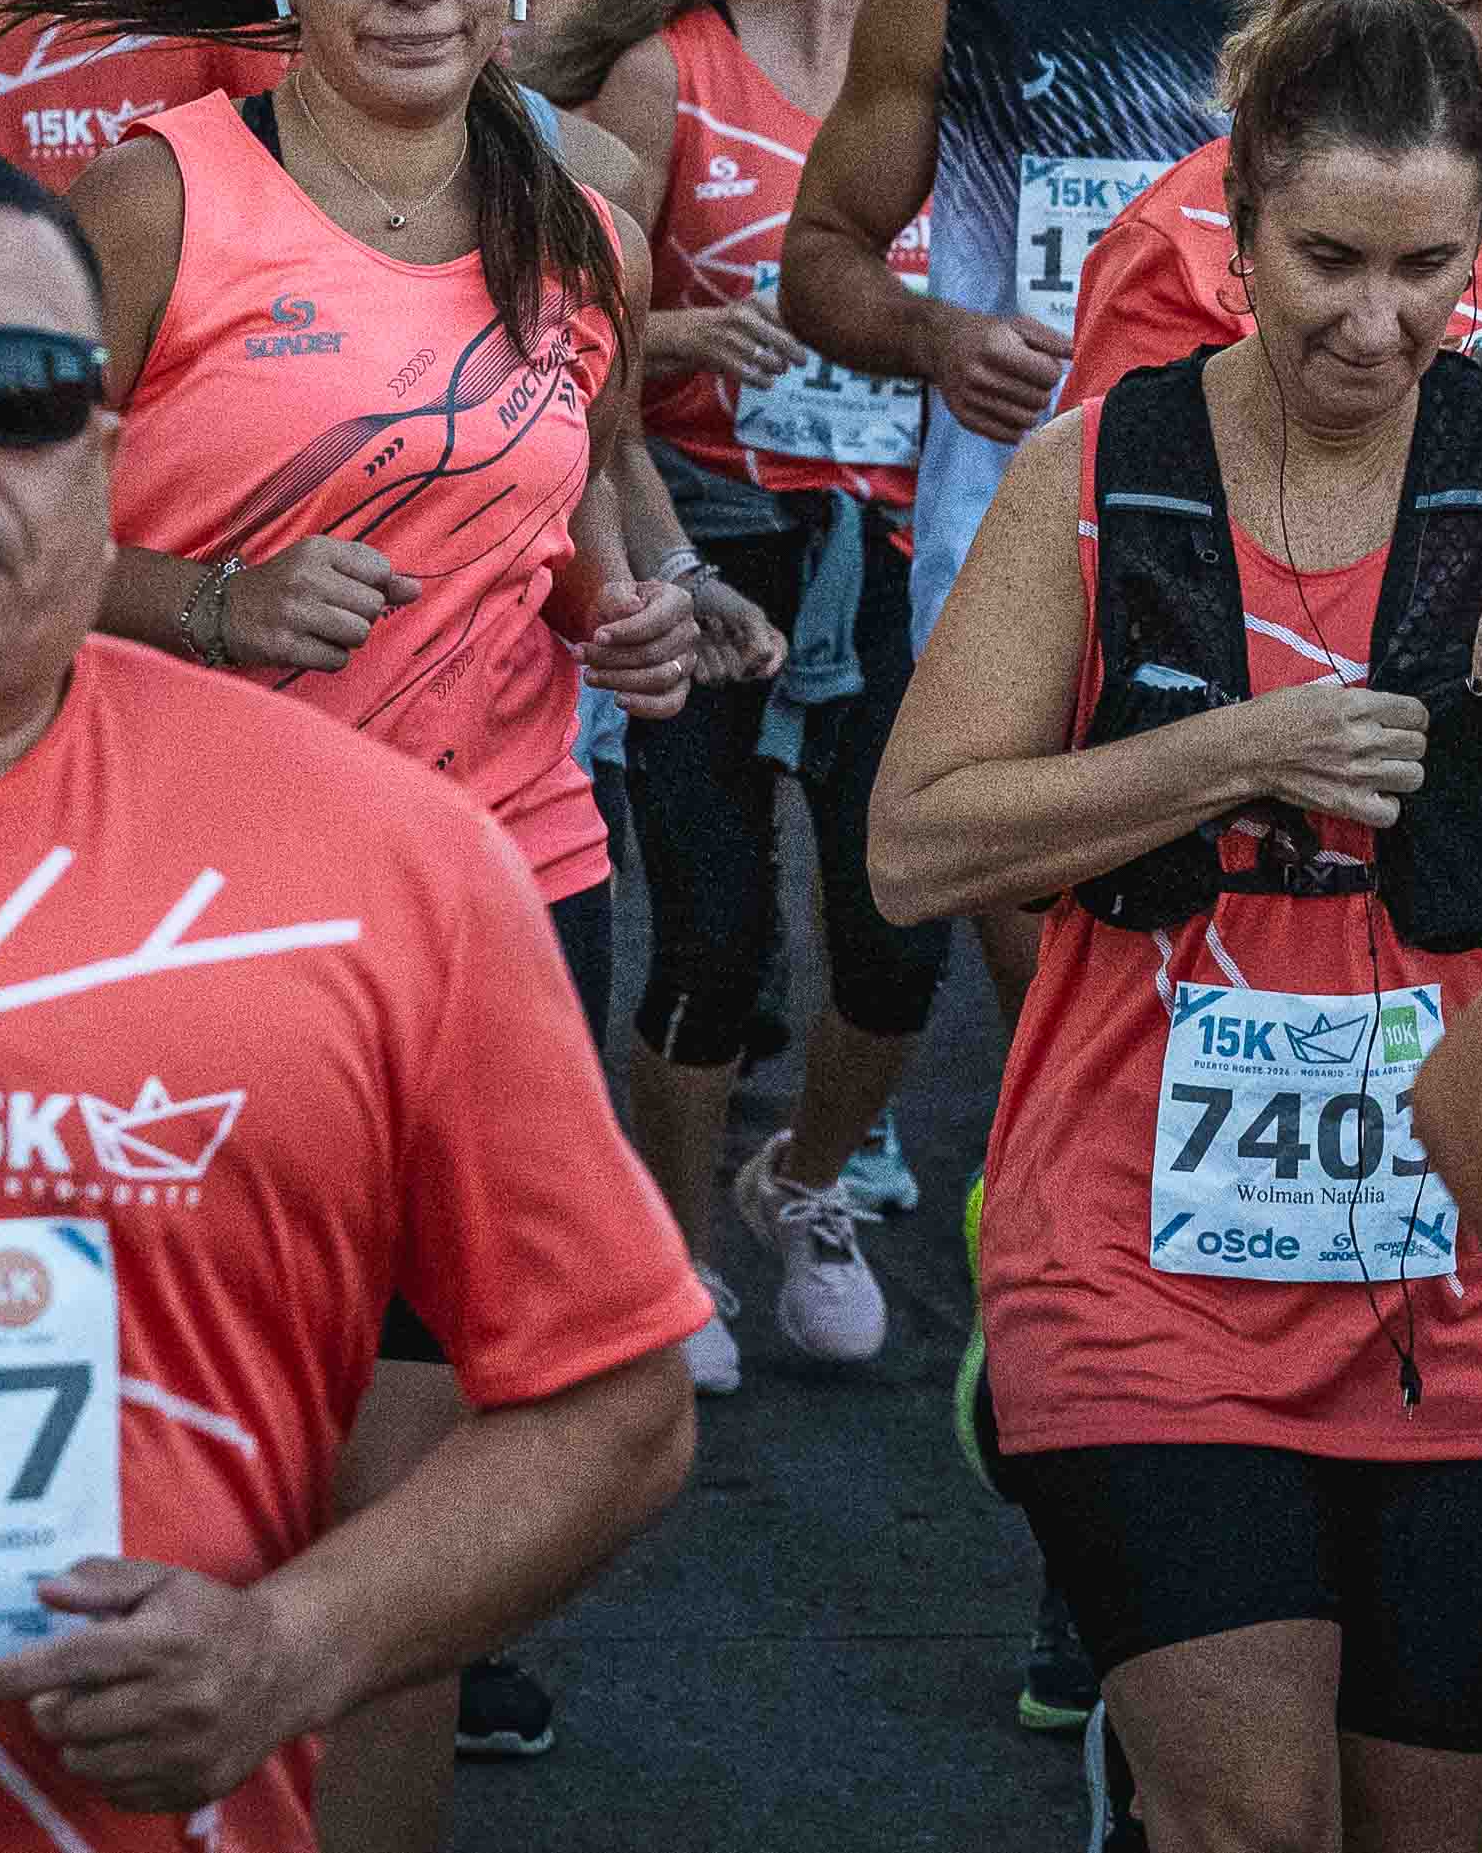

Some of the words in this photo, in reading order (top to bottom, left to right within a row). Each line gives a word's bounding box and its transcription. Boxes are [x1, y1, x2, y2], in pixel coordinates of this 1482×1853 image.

[21, 107, 95, 147] 15K
[1046, 177, 1108, 209] 15K
[1199, 1014, 1278, 1062] 15K
[1384, 1022, 1417, 1046] 10K
[1193, 1059, 1229, 1072] PUERTO
[1300, 1068, 1344, 1079] ROSARIO
[1237, 1183, 1315, 1205] Wolman
[1320, 1183, 1386, 1205] Natalia
[1197, 1227, 1301, 1264] osde
